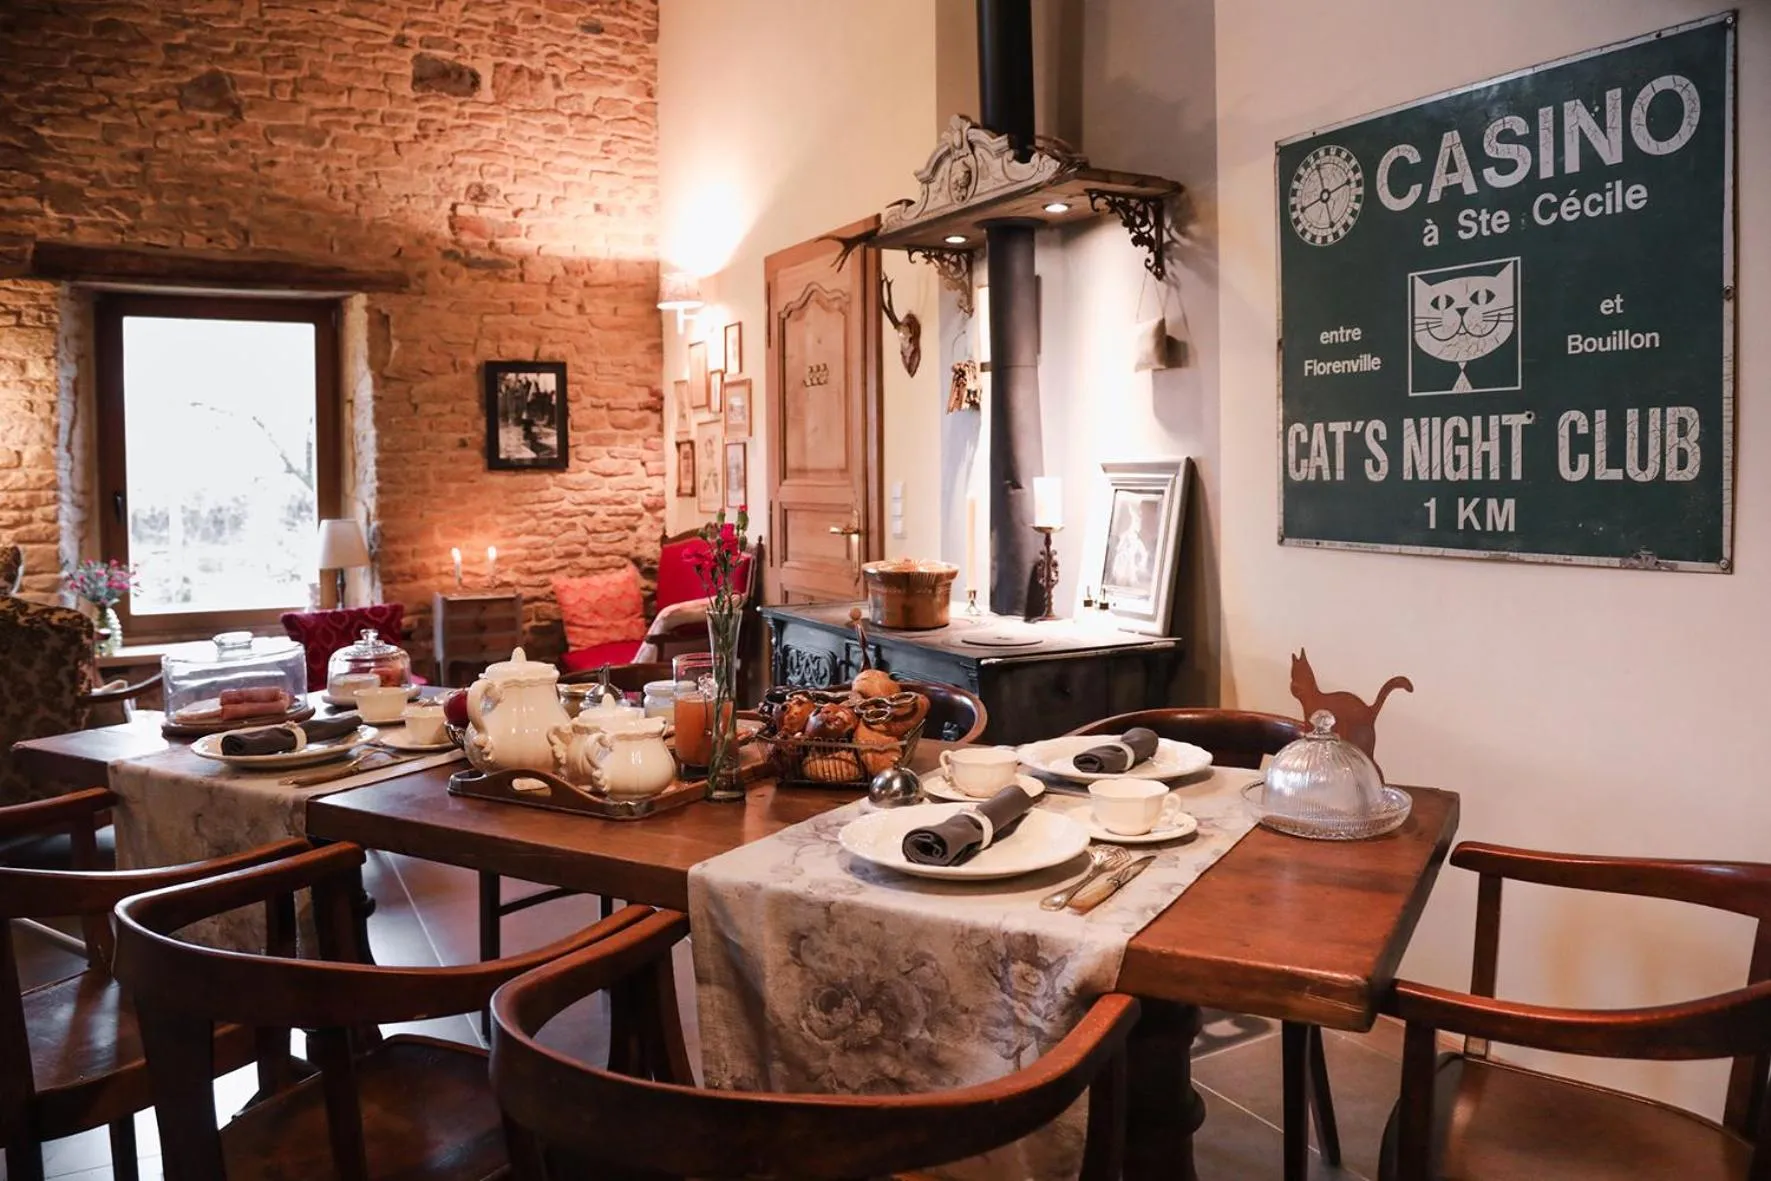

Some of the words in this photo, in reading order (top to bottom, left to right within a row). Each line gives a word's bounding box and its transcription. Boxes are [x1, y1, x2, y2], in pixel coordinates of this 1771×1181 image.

[1376, 74, 1701, 211] CASINO
[1423, 218, 1439, 246] à
[1457, 206, 1510, 241] Ste
[1532, 180, 1649, 227] Cécile
[1600, 293, 1624, 315] et
[1319, 325, 1362, 345] entre
[1567, 329, 1660, 355] Bouillon
[1304, 353, 1382, 377] Florenville
[1287, 419, 1389, 482] CAT'S
[1403, 413, 1533, 481] NIGHT
[1557, 406, 1701, 482] CLUB
[1423, 497, 1437, 529] 1
[1458, 497, 1516, 532] KM
